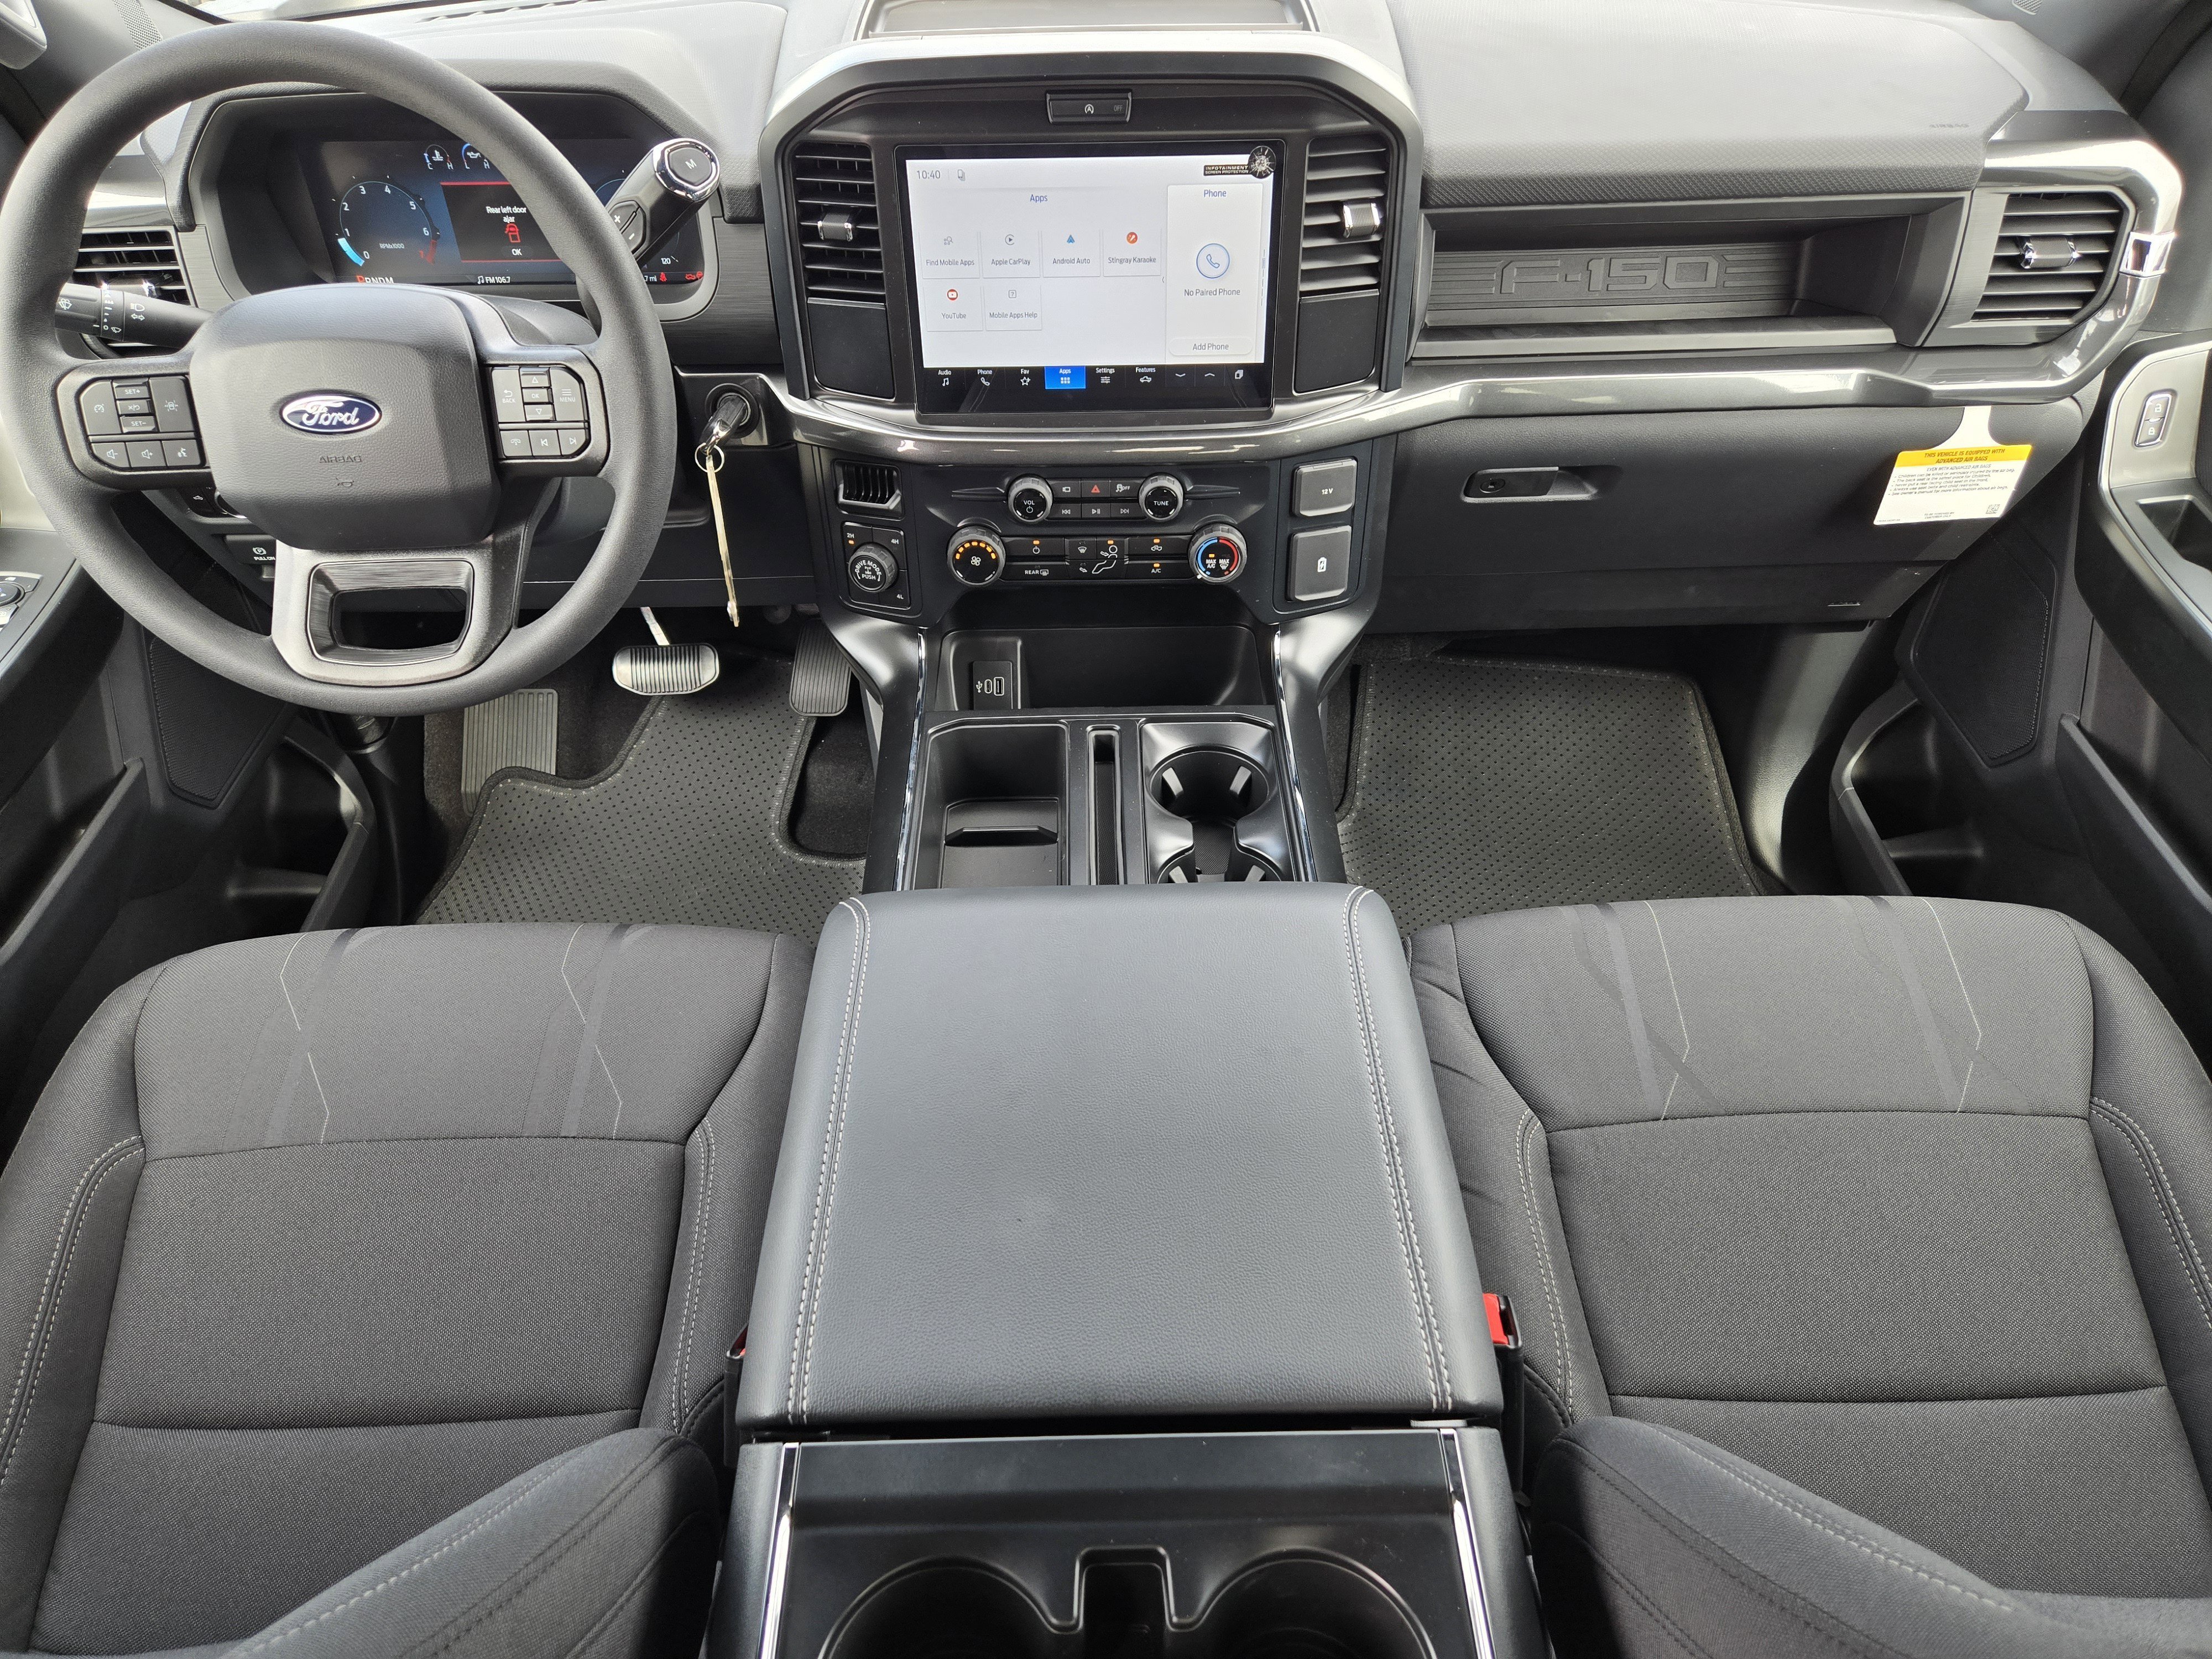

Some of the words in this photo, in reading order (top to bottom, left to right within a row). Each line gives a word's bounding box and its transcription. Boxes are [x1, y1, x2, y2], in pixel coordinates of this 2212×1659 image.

[685, 159, 697, 169] M
[917, 170, 941, 179] 10:40
[359, 186, 366, 194] 3
[385, 185, 391, 194] 4
[1204, 189, 1227, 197] Phone
[1030, 194, 1048, 203] Apps
[342, 202, 349, 211] 2
[409, 201, 416, 210] 5
[503, 215, 515, 223] ajar
[345, 228, 350, 237] 1
[1009, 258, 1031, 266] CarPlay
[1108, 257, 1132, 265] Stingray
[1500, 254, 1719, 294] F-150
[1024, 311, 1038, 320] Help
[302, 401, 359, 426] Ford
[319, 455, 362, 463] AIRBAG
[854, 560, 867, 573] DRIVE
[867, 560, 882, 576] MODE
